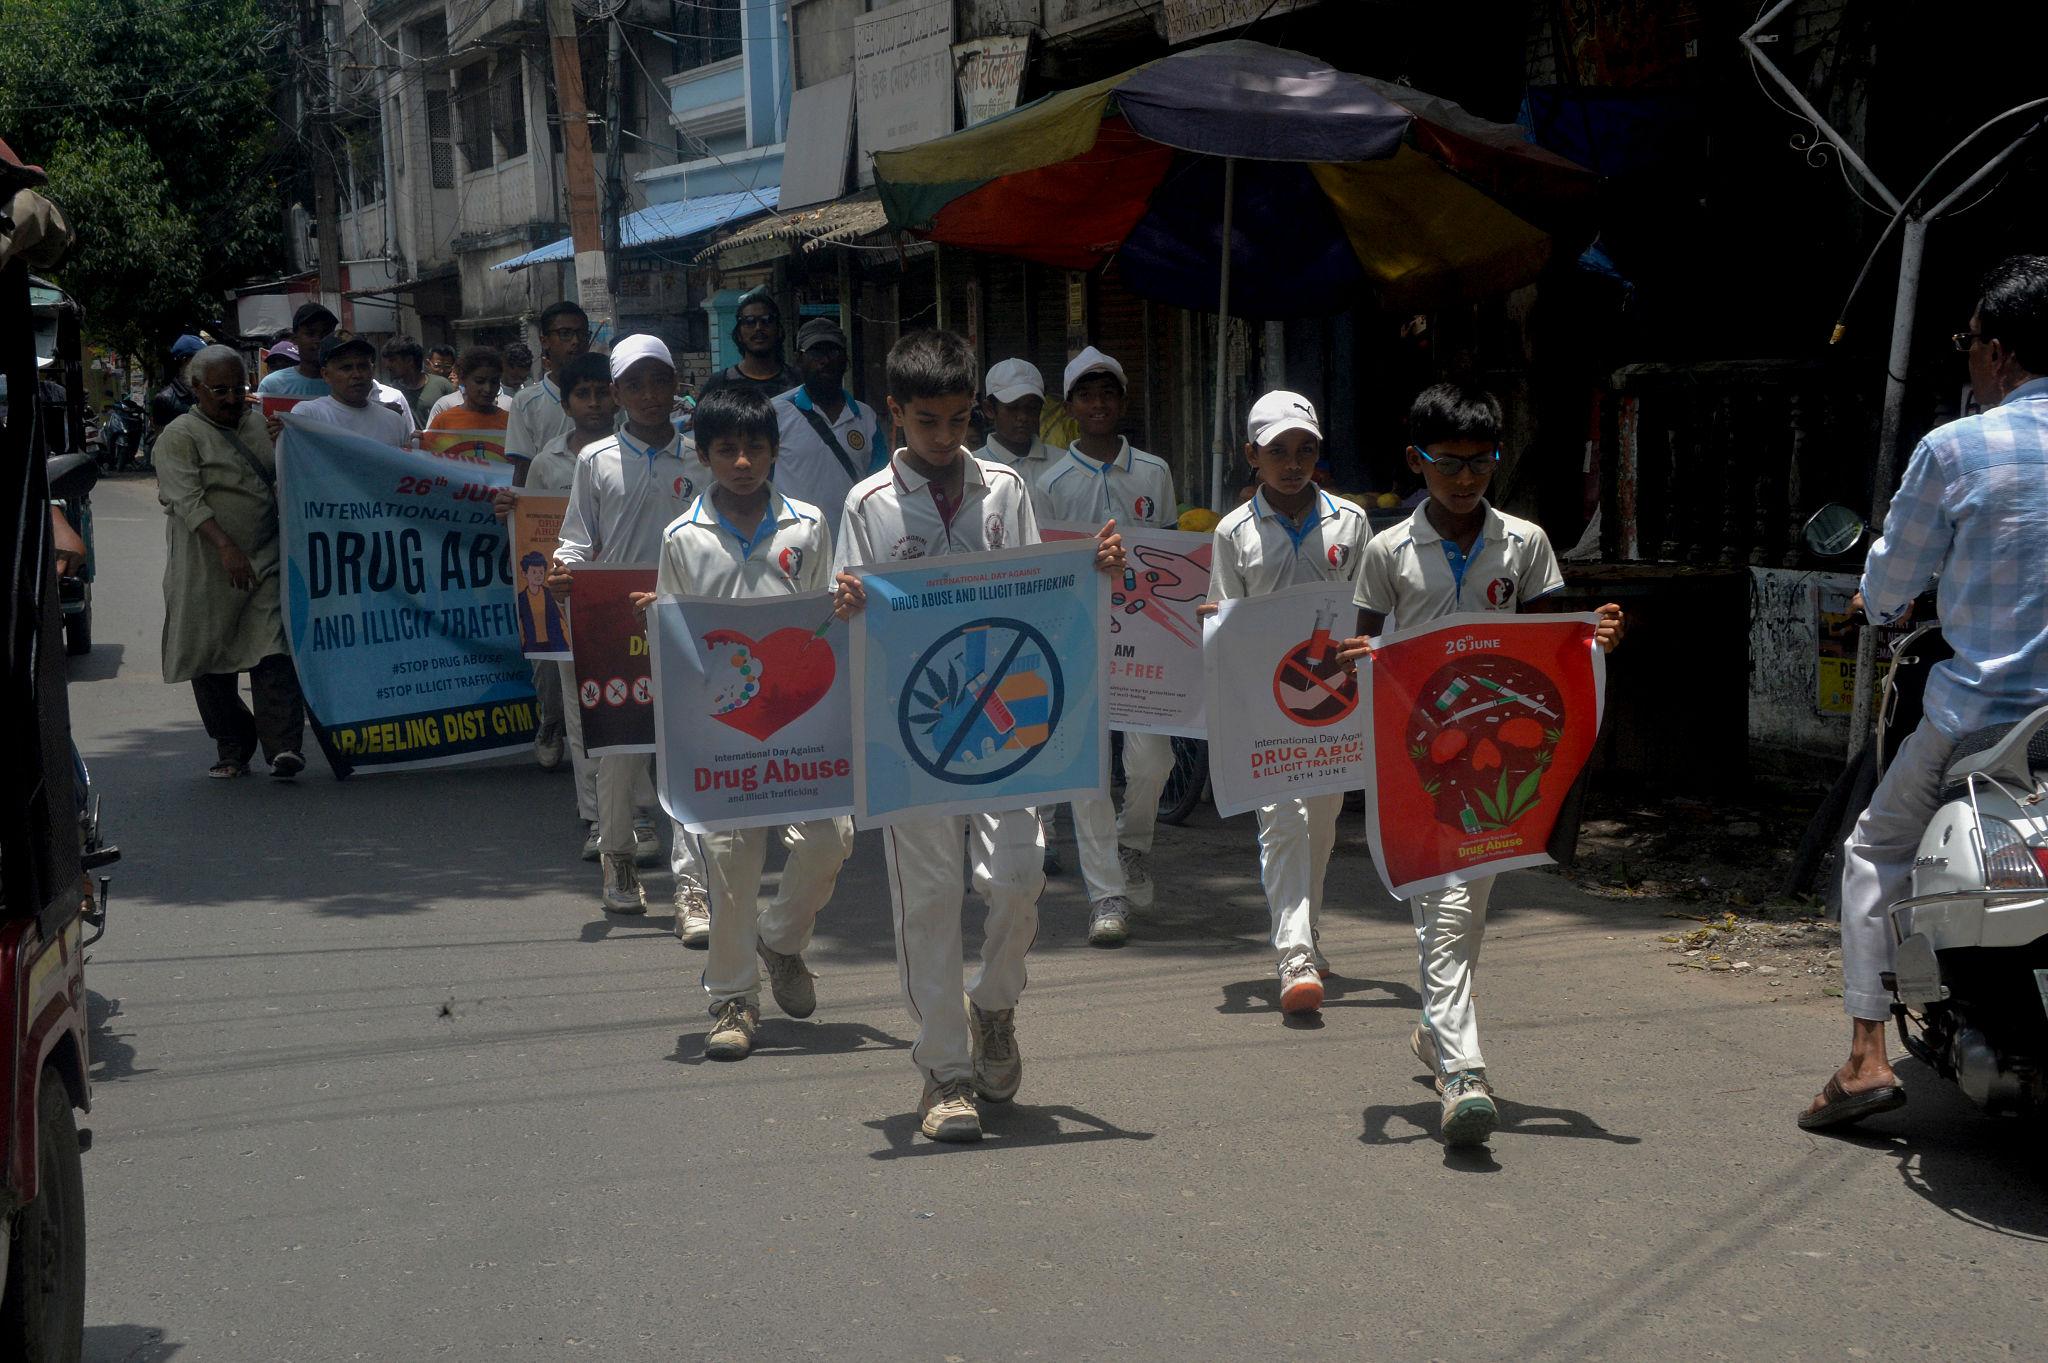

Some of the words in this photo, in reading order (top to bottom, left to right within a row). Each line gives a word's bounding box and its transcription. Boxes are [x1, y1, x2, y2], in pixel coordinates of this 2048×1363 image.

[396, 476, 448, 496] 26th
[304, 500, 462, 525] INTERNATIONAL
[468, 511, 500, 526] DA
[308, 528, 426, 599] DRUG
[926, 574, 990, 588] INTERNATIONAL
[991, 571, 1007, 581] DAY
[1008, 567, 1041, 579] AGAINST
[891, 595, 919, 612] DRUG
[921, 590, 953, 609] ABUSE
[956, 587, 976, 604] AND
[979, 583, 1013, 601] ILLICIT
[1014, 574, 1075, 597] TRAFFICKING
[312, 614, 356, 651] AND
[362, 607, 436, 645] ILLICIT
[1114, 644, 1136, 658] AM
[1445, 634, 1474, 655] 26th
[1468, 639, 1501, 651] JUNE
[391, 660, 429, 675] #STOP
[432, 655, 460, 670] DRUG
[463, 653, 504, 667] ABUSE
[376, 684, 412, 700] #STOP
[415, 678, 452, 695] ILLICIT
[454, 671, 525, 690] TRAFFICKING
[443, 708, 487, 743] DIST
[491, 703, 534, 736] GYM
[1255, 735, 1316, 749] International
[1319, 734, 1338, 744] Day
[714, 748, 771, 763] International
[772, 748, 788, 758] Day
[790, 745, 825, 757] Against
[1251, 747, 1307, 768] DRUG
[694, 765, 758, 792] Drug
[763, 756, 850, 784] Abuse
[1252, 770, 1261, 779] &
[1264, 761, 1303, 777] ILLICIT
[1288, 772, 1313, 782] 26TH
[1318, 767, 1347, 777] JUNE
[728, 793, 744, 804] and
[745, 791, 769, 801] Illicit
[771, 787, 819, 798] Trafficking
[1457, 844, 1484, 858] Drug
[1486, 837, 1523, 851] Abuse
